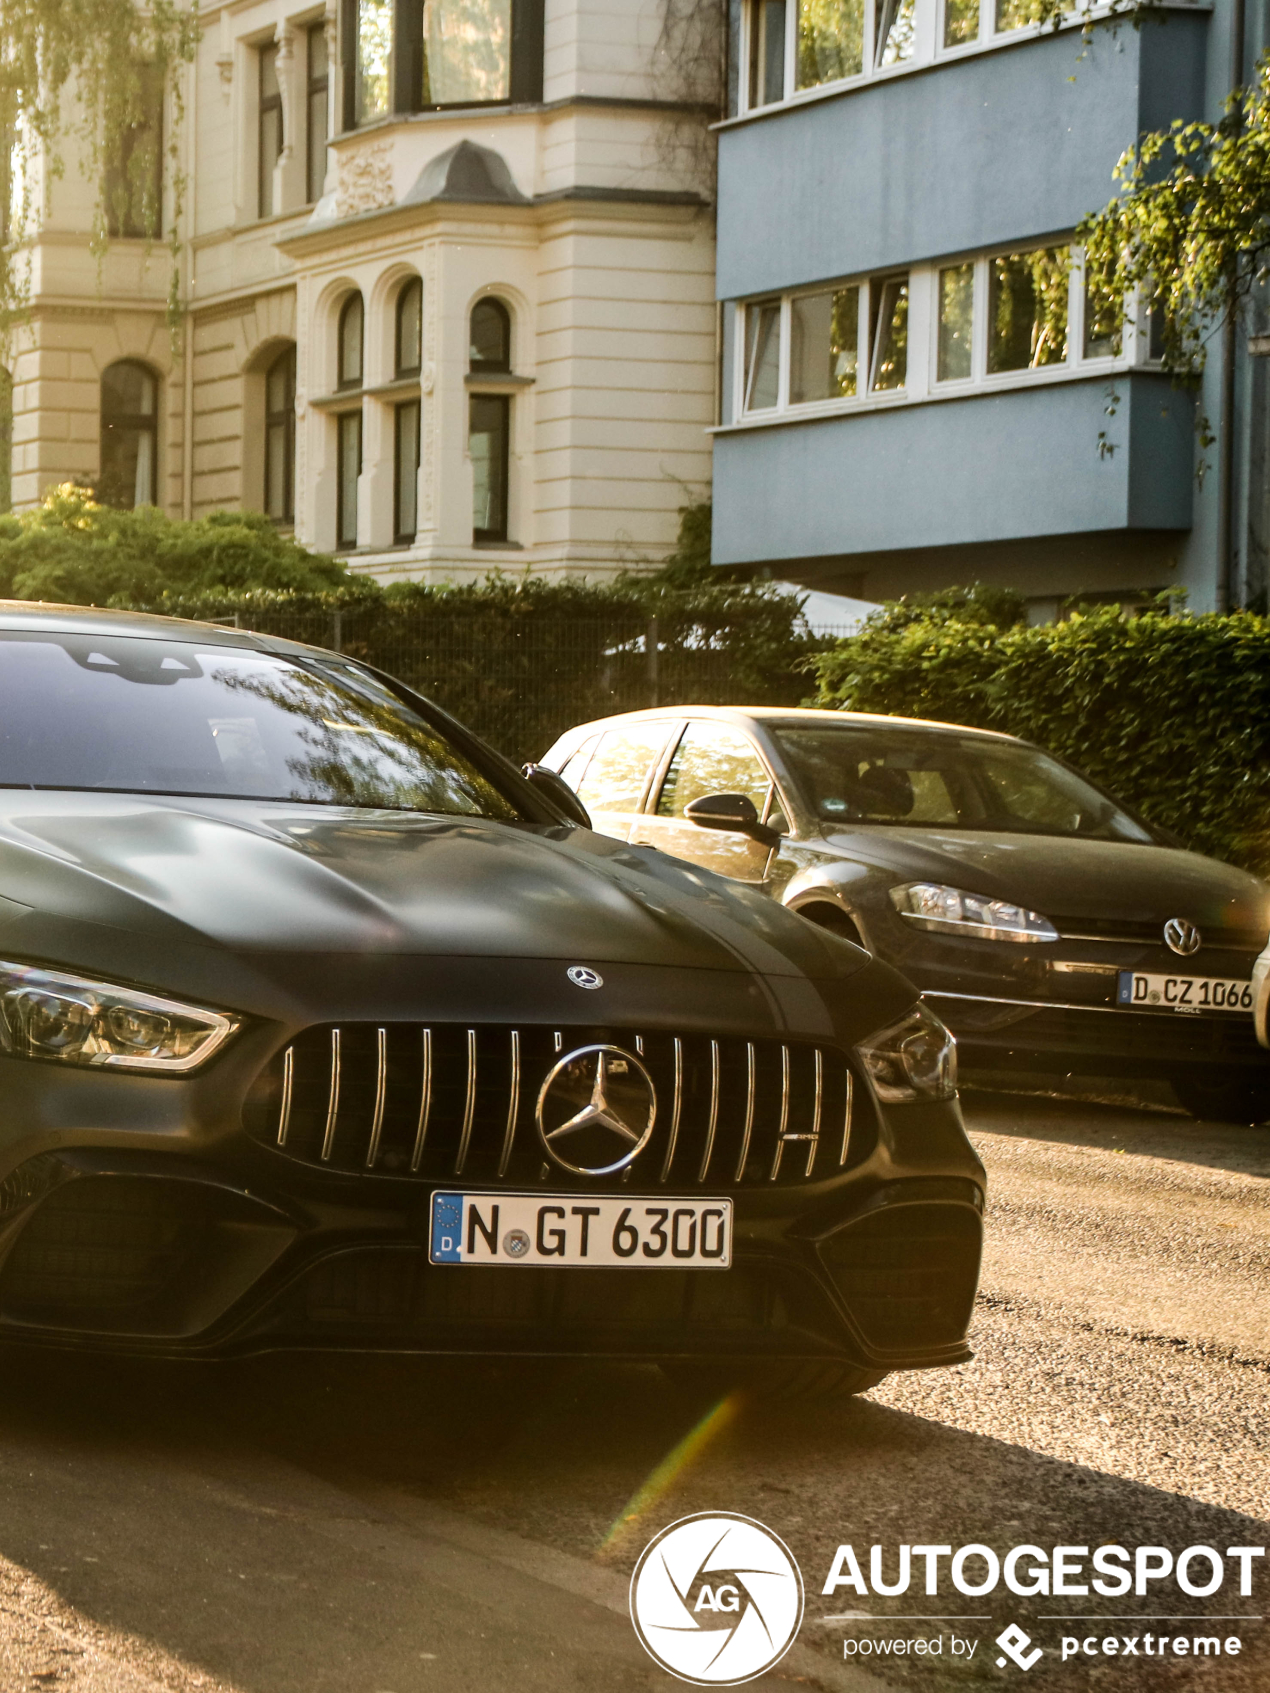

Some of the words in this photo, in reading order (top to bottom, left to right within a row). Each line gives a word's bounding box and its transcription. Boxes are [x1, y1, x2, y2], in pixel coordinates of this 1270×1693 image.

[1133, 977, 1148, 1001] D
[1164, 979, 1193, 1004] CZ
[1198, 981, 1253, 1008] 1066
[441, 1236, 453, 1251] D
[466, 1203, 499, 1255] N
[535, 1206, 600, 1257] GT
[612, 1207, 725, 1258] 6300
